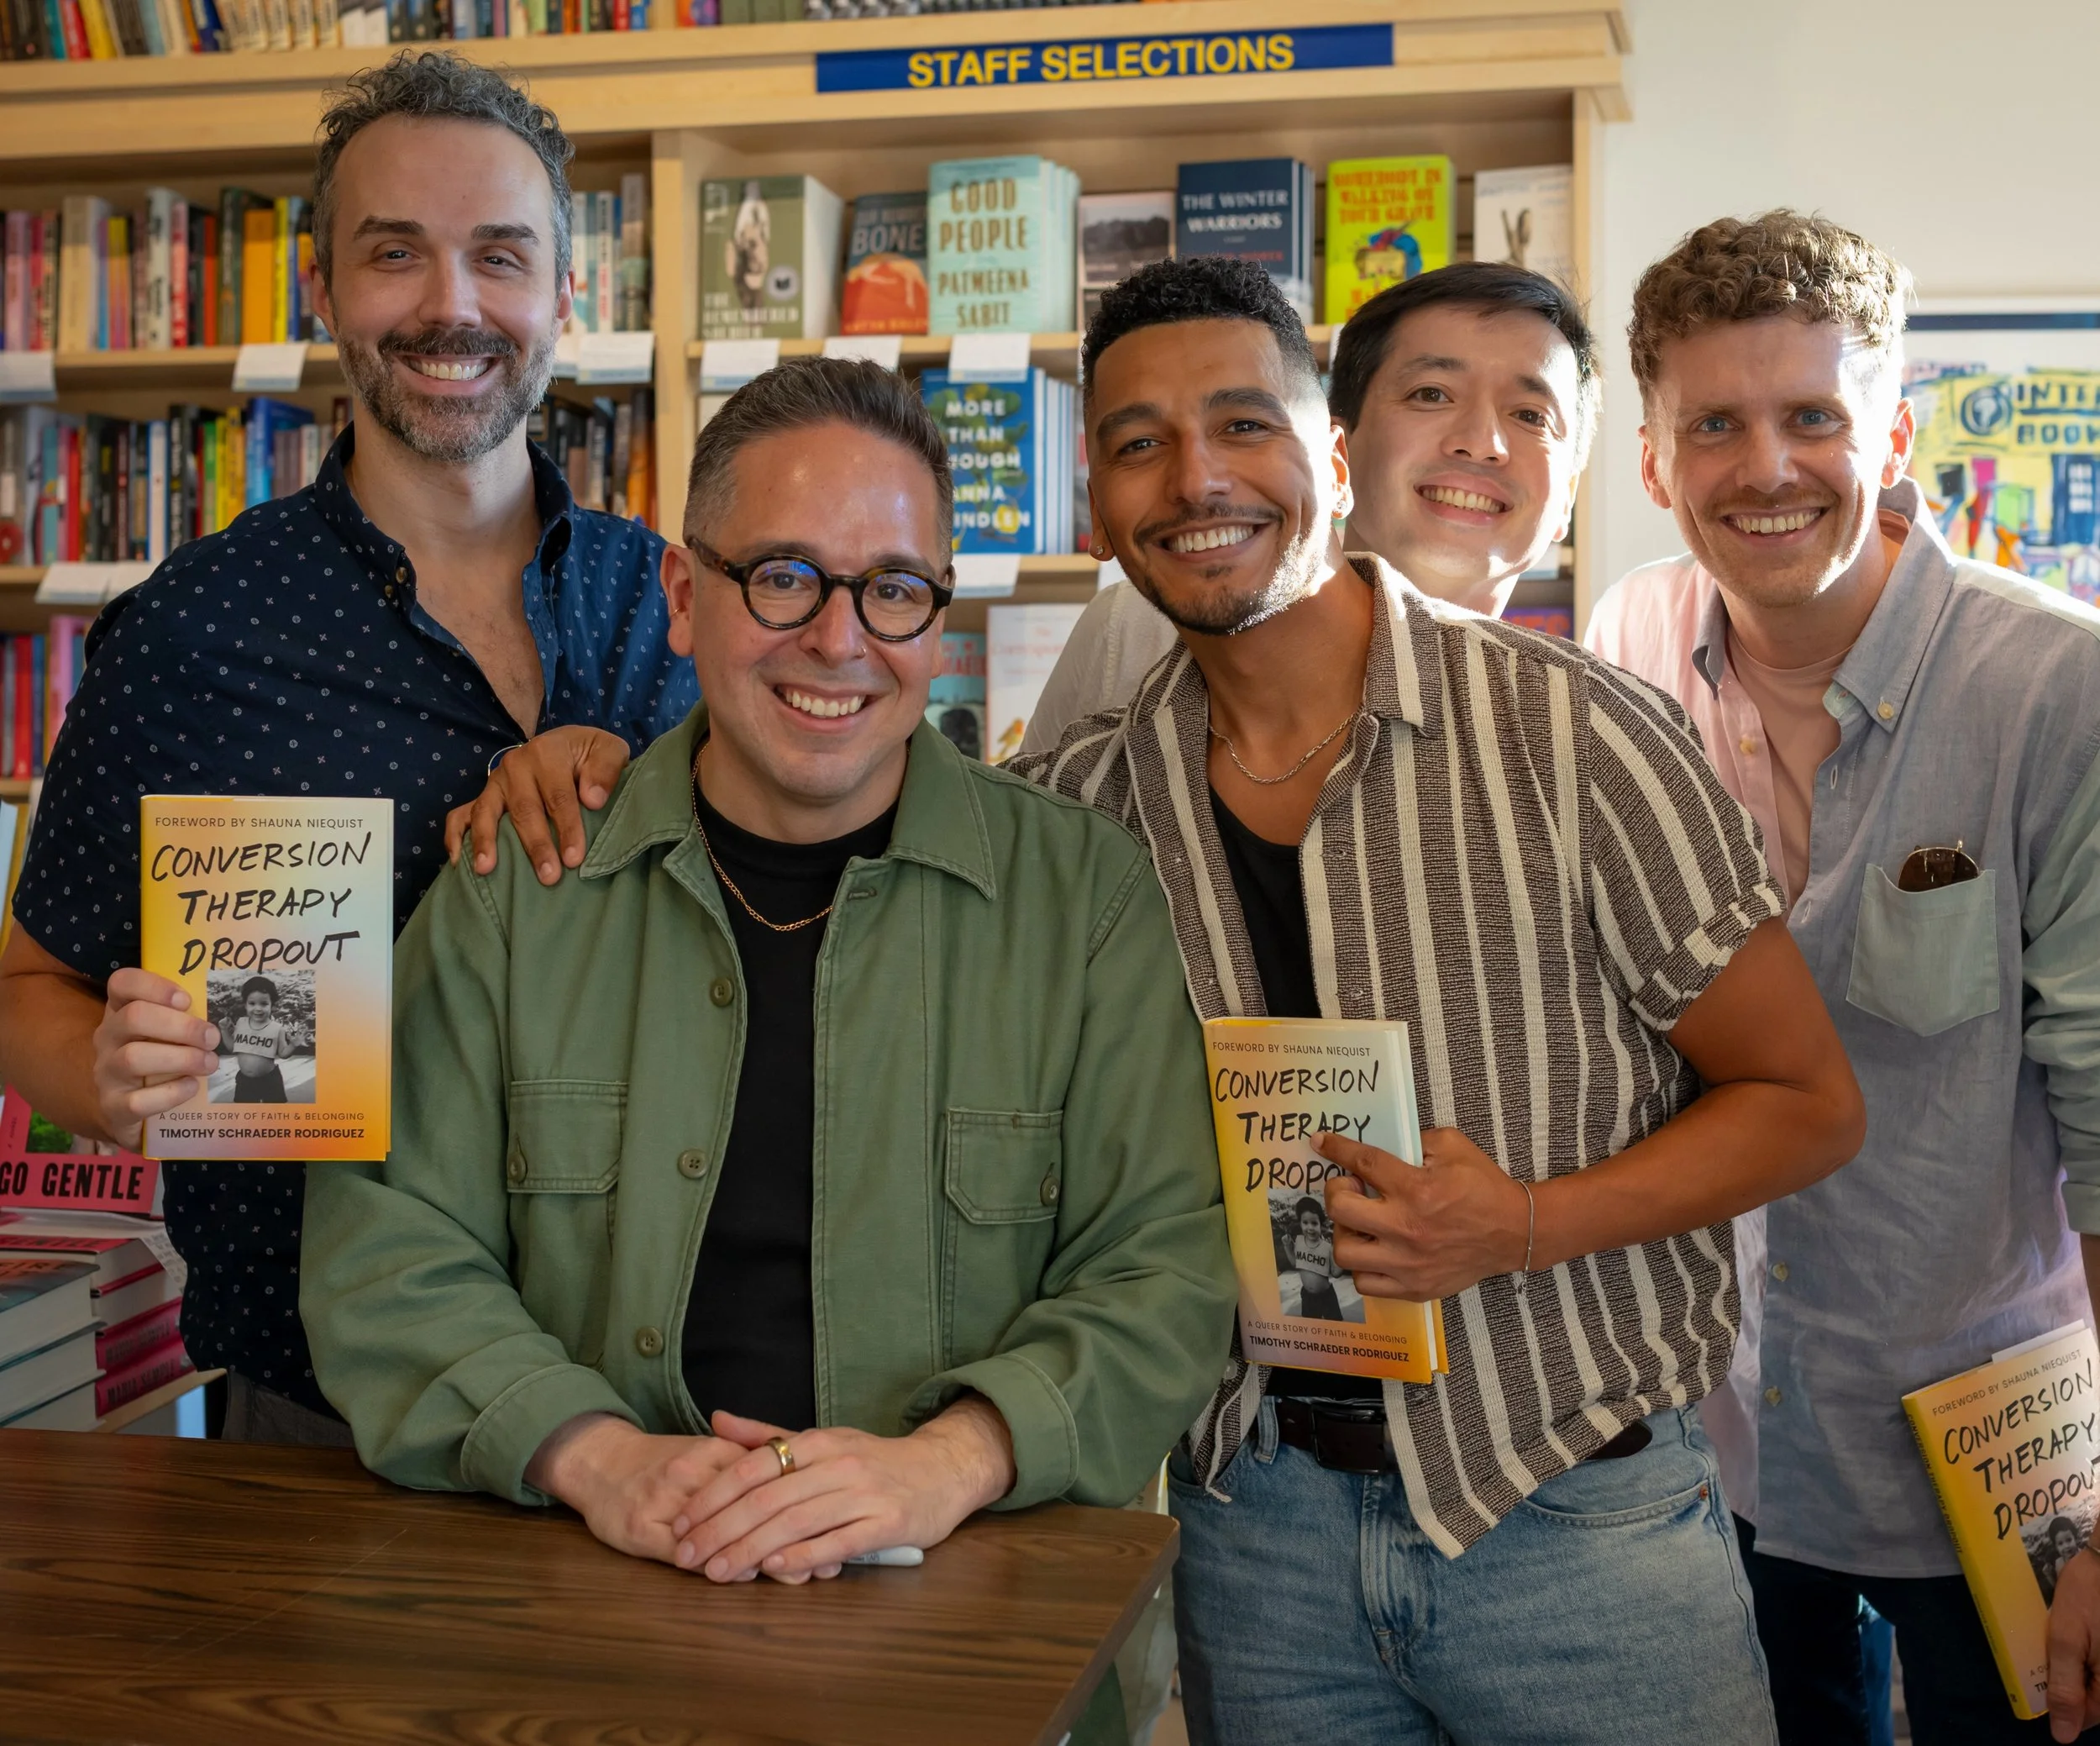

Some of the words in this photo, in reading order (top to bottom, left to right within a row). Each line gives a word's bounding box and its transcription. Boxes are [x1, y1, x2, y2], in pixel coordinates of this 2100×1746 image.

[909, 48, 1032, 87] STAFF
[1041, 34, 1295, 82] SELECTIONS
[950, 177, 1016, 213] GOOD
[1181, 192, 1215, 211] THE
[1219, 189, 1289, 208] WINTER
[939, 216, 1027, 253] PEOPLE
[1186, 211, 1284, 233] WARRIORS
[945, 398, 1007, 417] MORE
[948, 426, 1005, 444] THAN
[948, 451, 1021, 471] NOUGH
[953, 485, 1007, 502] ANNA
[953, 510, 1032, 529] INDLEN
[155, 817, 226, 828] FOREWORD
[231, 818, 245, 828] BY
[250, 818, 302, 828] SHAUNA
[307, 818, 364, 829] NIEQUIST
[151, 831, 371, 882] CONVERSION
[177, 887, 352, 925] THERAPY
[178, 930, 360, 976] DROPOUT
[234, 1033, 274, 1049] MACHO
[1213, 1041, 1265, 1053] FOREWORD
[1268, 1044, 1279, 1054] BY
[1284, 1044, 1323, 1055] SHAUNA
[1326, 1045, 1371, 1057] NIEQUIST
[1215, 1060, 1379, 1102] CONVERSION
[159, 1112, 166, 1121] A
[169, 1112, 203, 1121] QUEER
[207, 1112, 240, 1121] STORY
[244, 1112, 257, 1121] OF
[261, 1112, 291, 1121] FAITH
[294, 1112, 301, 1121] &
[305, 1112, 365, 1121] BELONGING
[1236, 1111, 1372, 1144] THERAPY
[159, 1128, 214, 1139] TIMOTHY
[218, 1128, 291, 1139] SCHRAEDER
[294, 1128, 365, 1139] RODRIGUEZ
[0, 1160, 29, 1196] GO
[42, 1162, 144, 1200] GENTLE
[1245, 1158, 1347, 1195] DROPO
[1295, 1250, 1327, 1267] MACHO
[1247, 1320, 1254, 1328] A
[1255, 1321, 1280, 1332] QUEER
[1283, 1323, 1309, 1335] STORY
[1311, 1326, 1321, 1335] OF
[1325, 1328, 1347, 1338] FAITH
[1350, 1331, 1357, 1339] &
[1359, 1332, 1407, 1344] BELONGING
[1250, 1335, 1291, 1350] TIMOTHY
[1294, 1340, 1351, 1356] SCHRAEDER
[1353, 1348, 1410, 1363] RODRIGUEZ
[1933, 1390, 1986, 1417] FOREWORD
[1988, 1382, 2000, 1395] BY
[2003, 1367, 2040, 1389] SHAUNA
[2042, 1349, 2082, 1373] NIEQUIST
[1944, 1358, 2093, 1465] CONVERSION
[1907, 1413, 1932, 1470] CONVERSION
[1929, 1471, 1947, 1512] THERAPY
[1973, 1412, 2096, 1493] THERAPY
